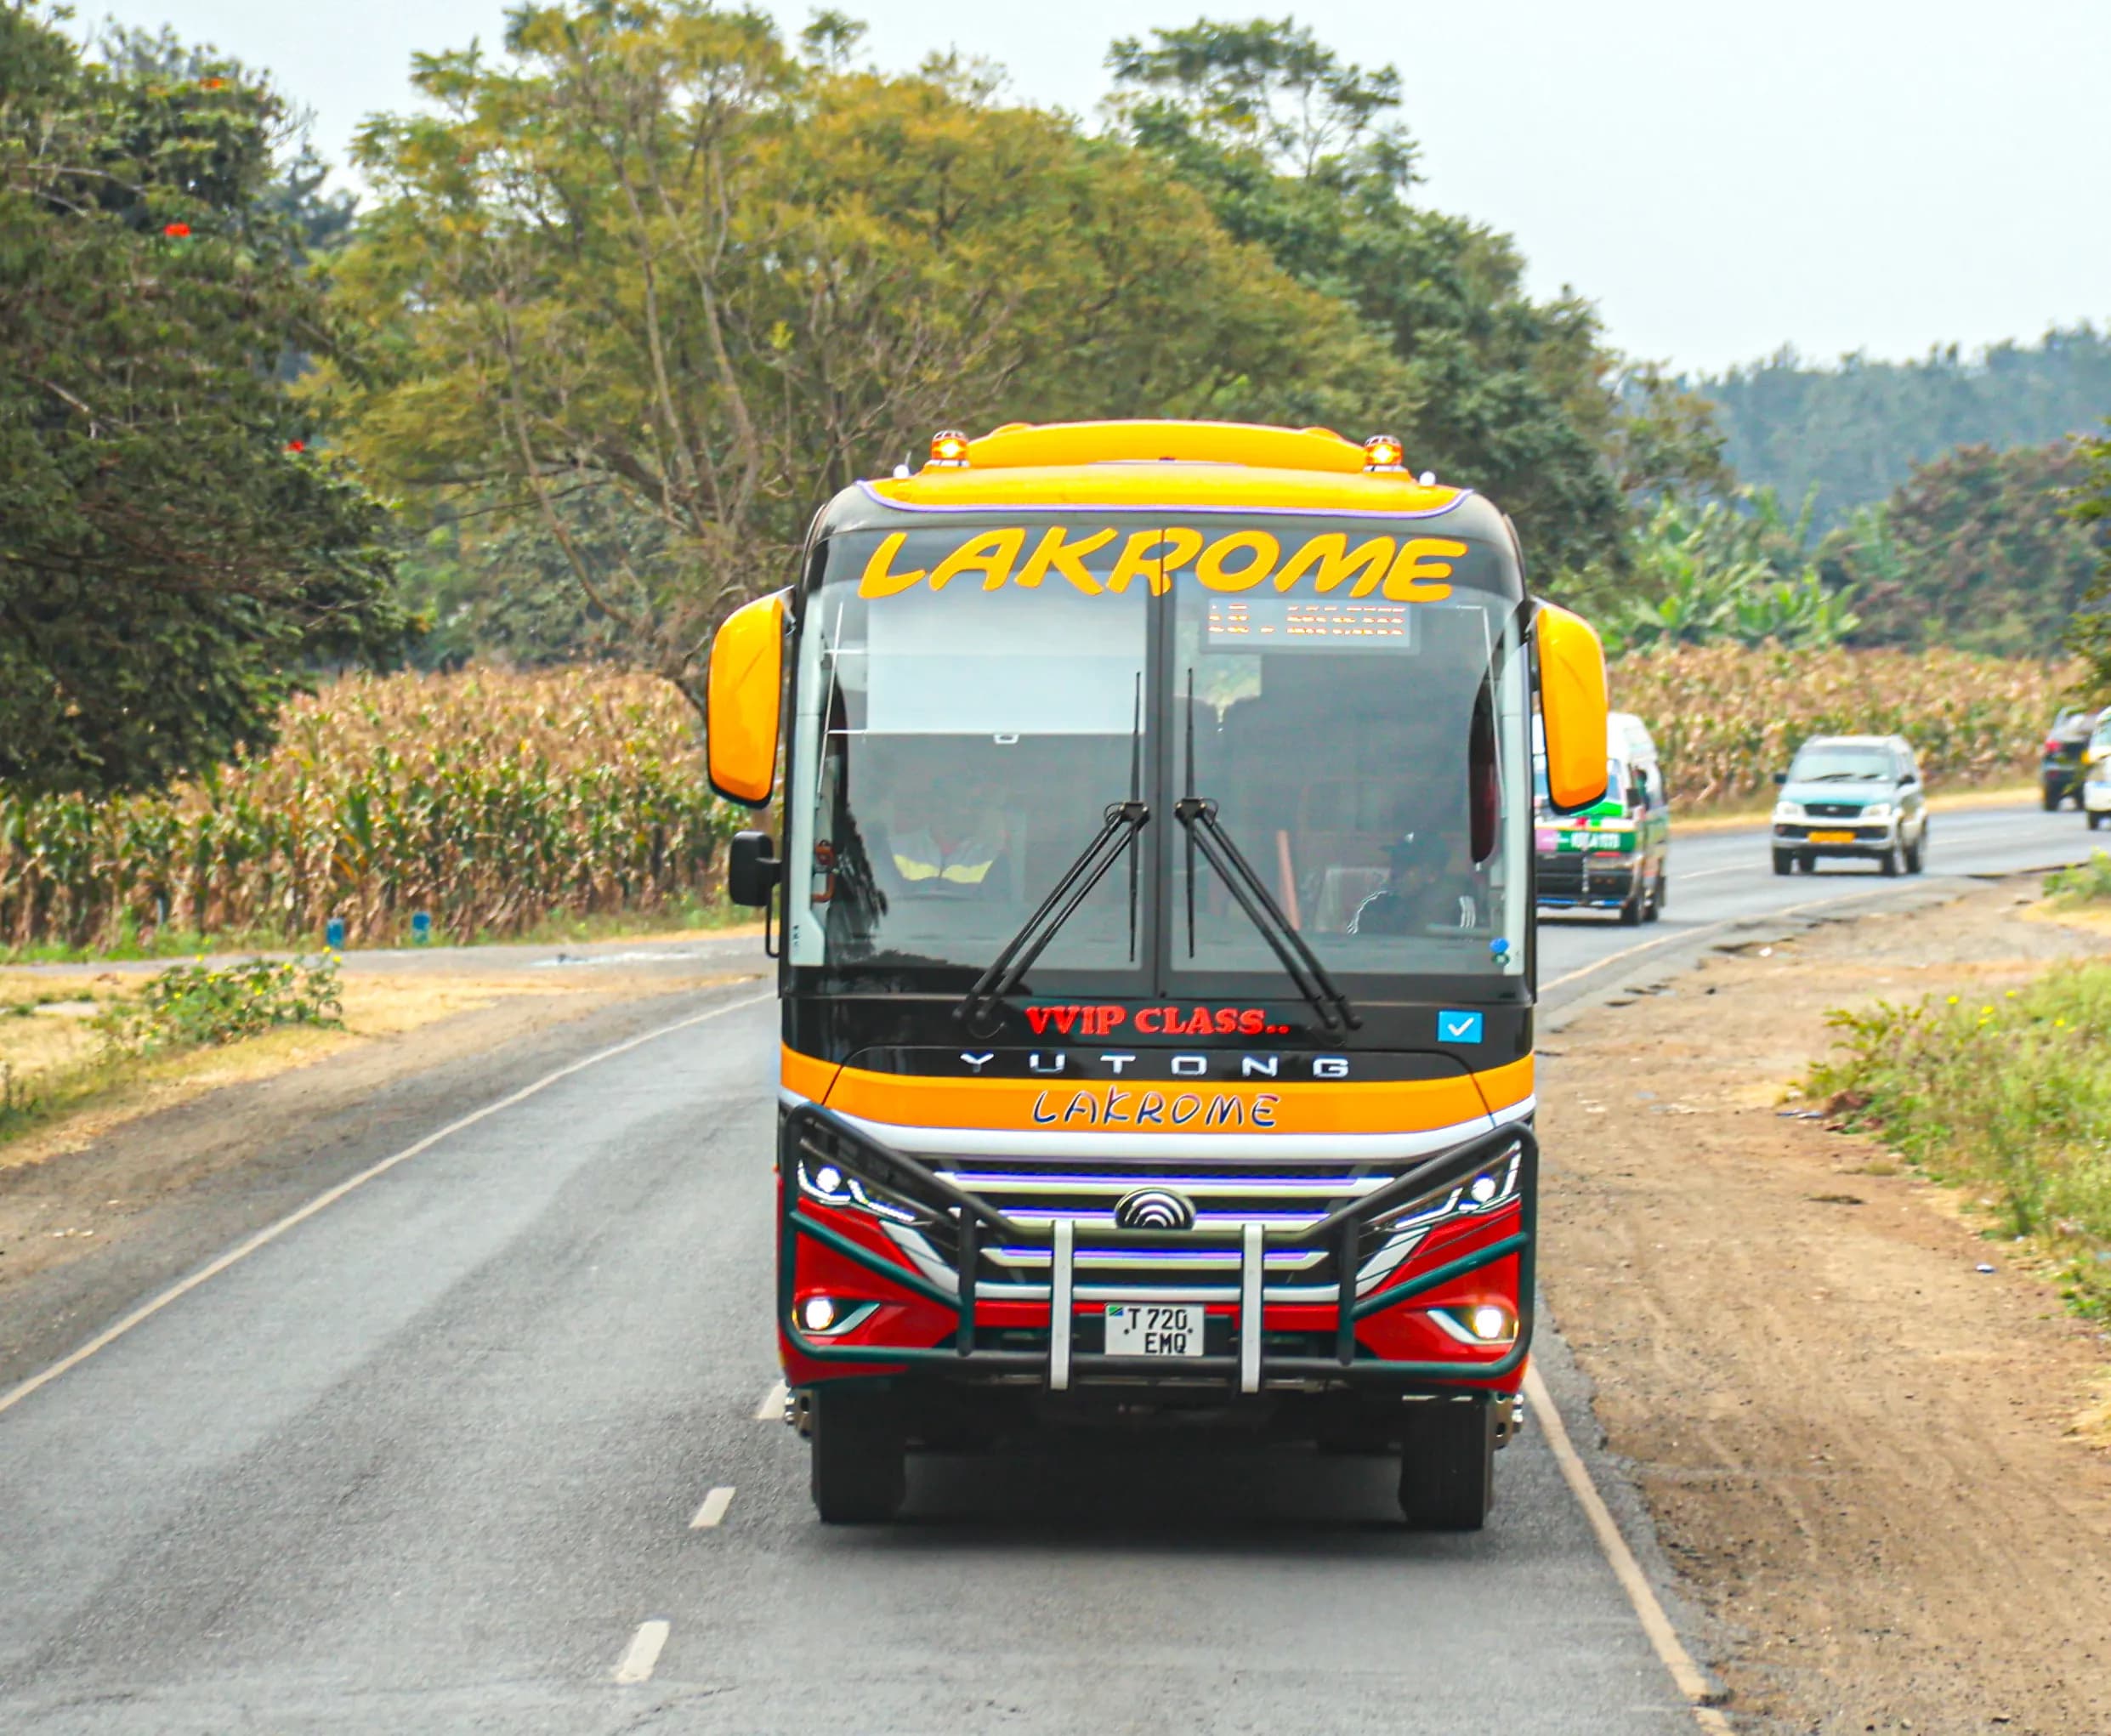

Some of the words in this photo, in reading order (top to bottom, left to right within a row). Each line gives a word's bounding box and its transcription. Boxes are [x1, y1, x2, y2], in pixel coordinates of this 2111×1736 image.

[857, 525, 1467, 602] LAKROME
[1024, 1005, 1126, 1035] VVIP
[959, 1052, 1350, 1078] YUTONG
[1032, 1085, 1280, 1128] LAKROME
[1128, 1308, 1141, 1330] T
[1147, 1308, 1188, 1330] 720
[1144, 1332, 1187, 1353] EMQ
